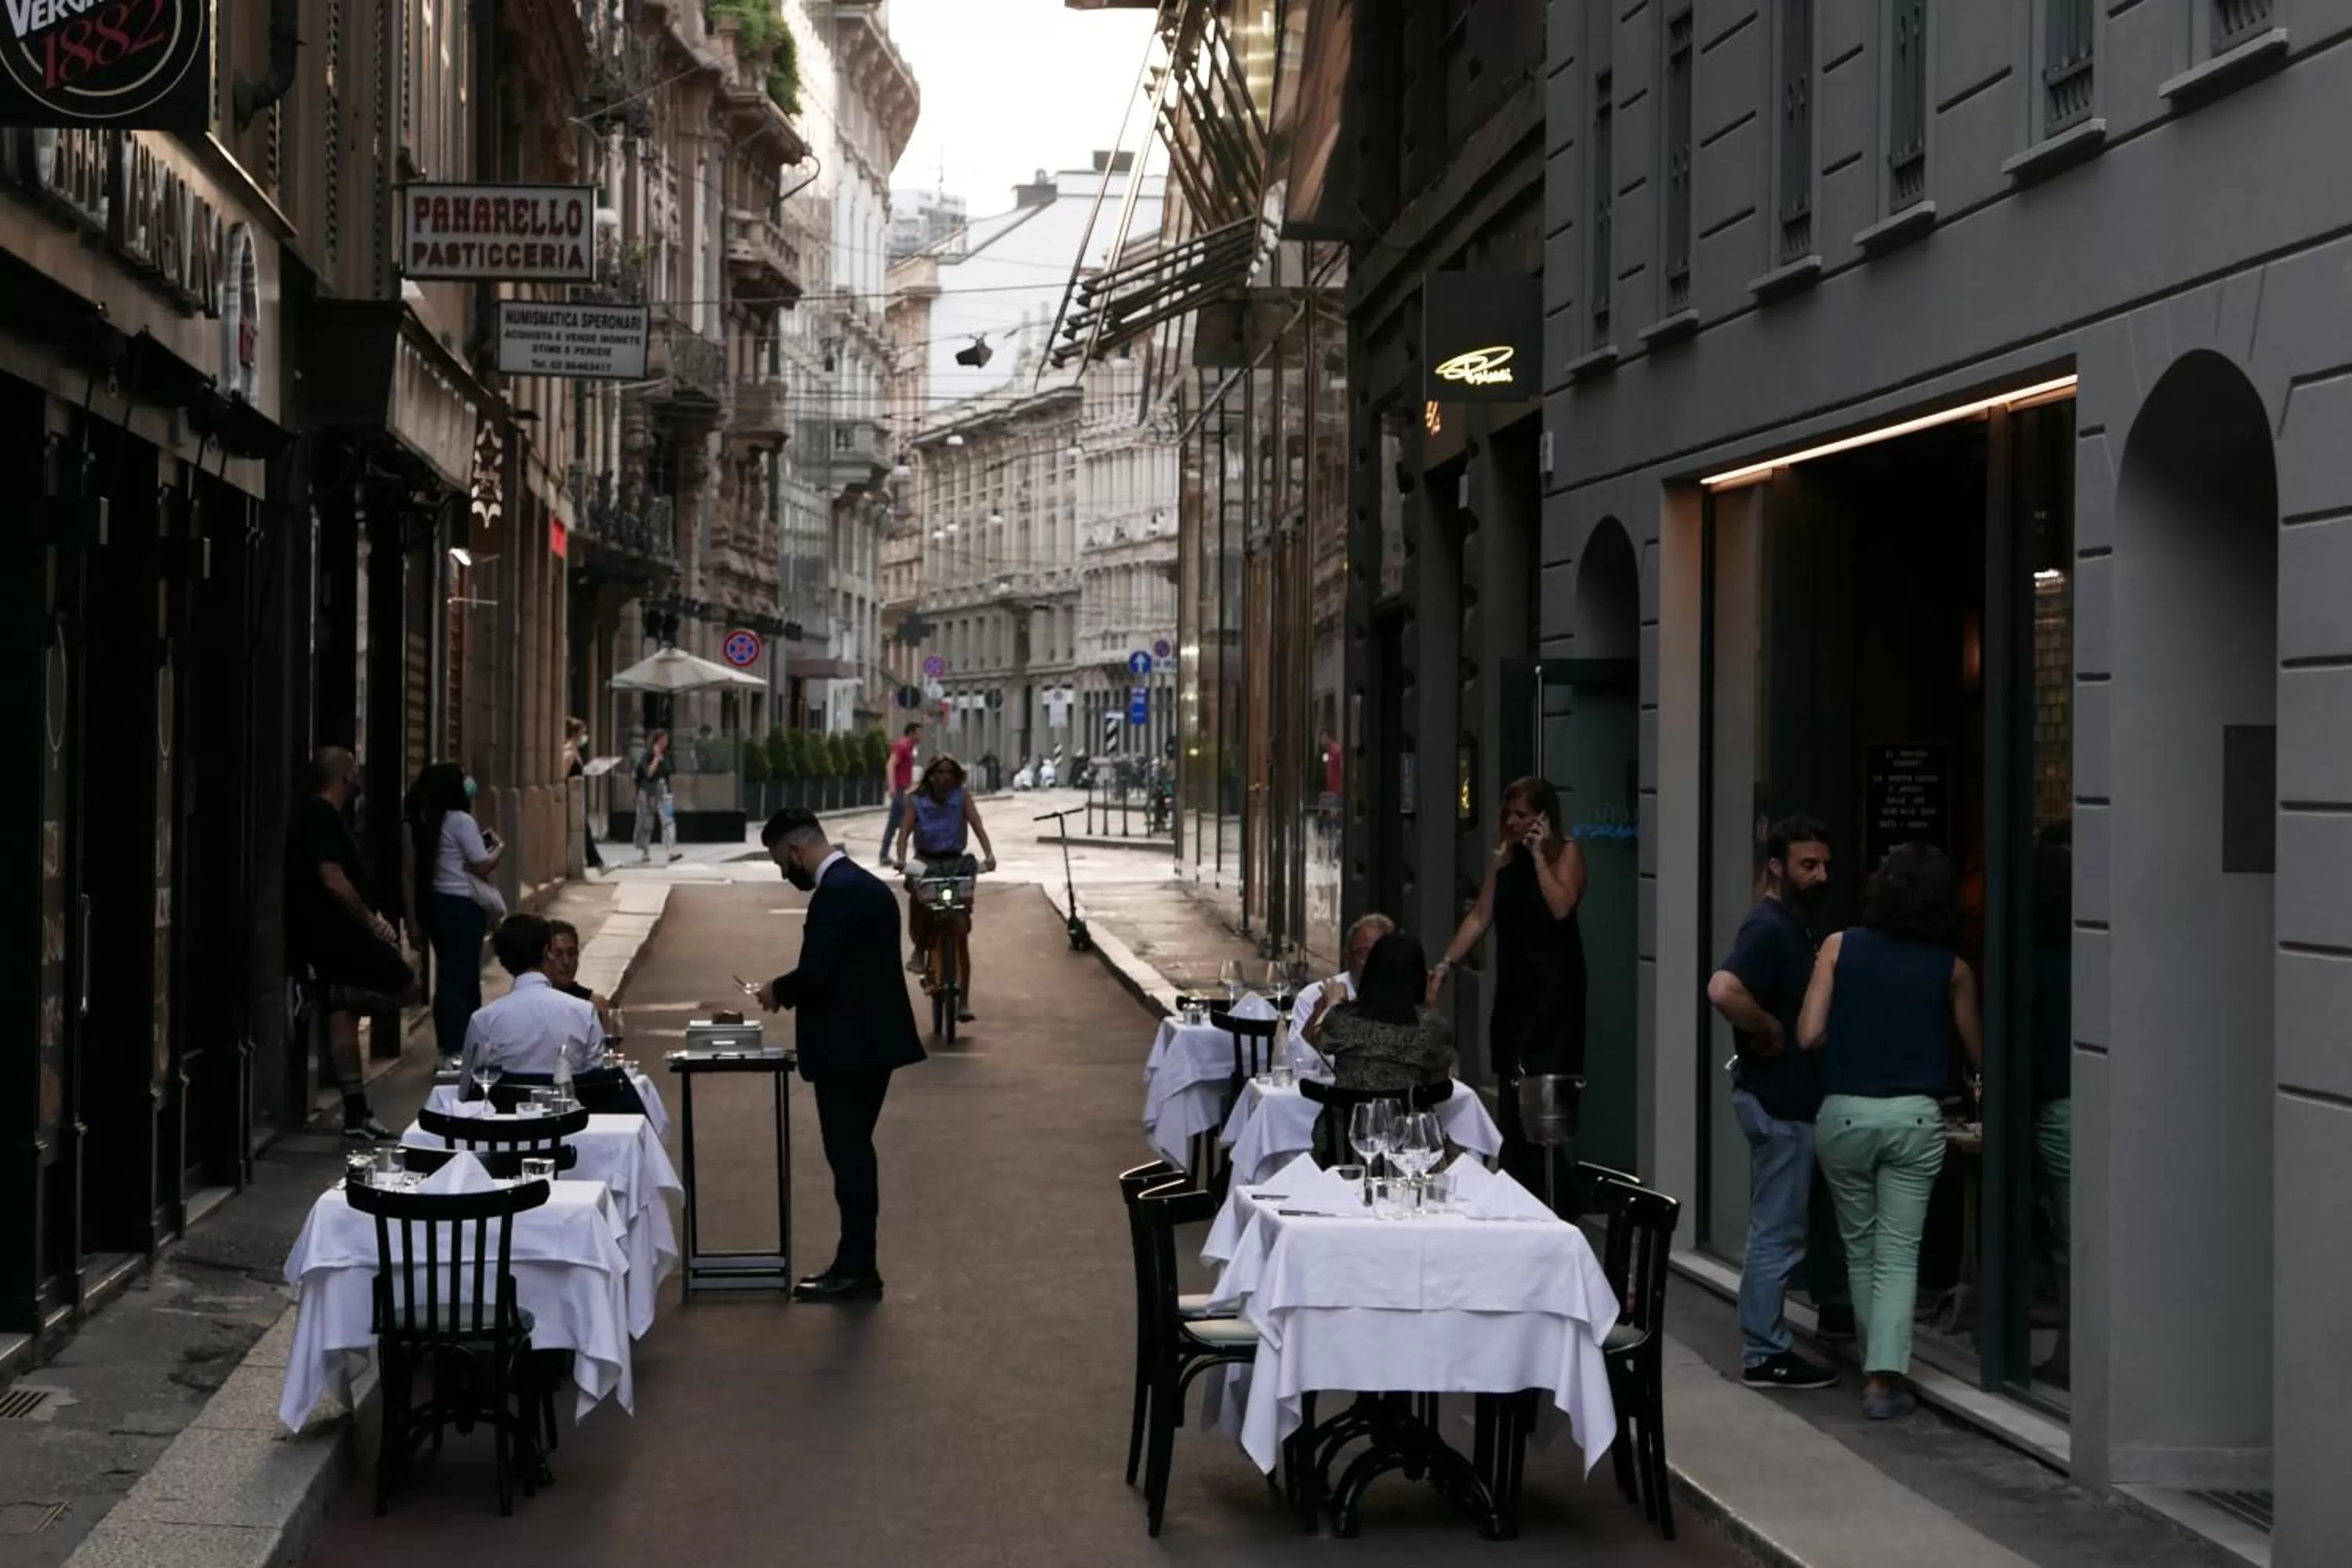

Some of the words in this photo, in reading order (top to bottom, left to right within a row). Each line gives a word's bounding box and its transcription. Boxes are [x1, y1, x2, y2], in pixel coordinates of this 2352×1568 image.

[40, 0, 165, 93] 1882
[412, 241, 584, 270] PASTICCERIA
[505, 310, 579, 327] NUMISMATICA
[582, 312, 641, 330] SPERONARI
